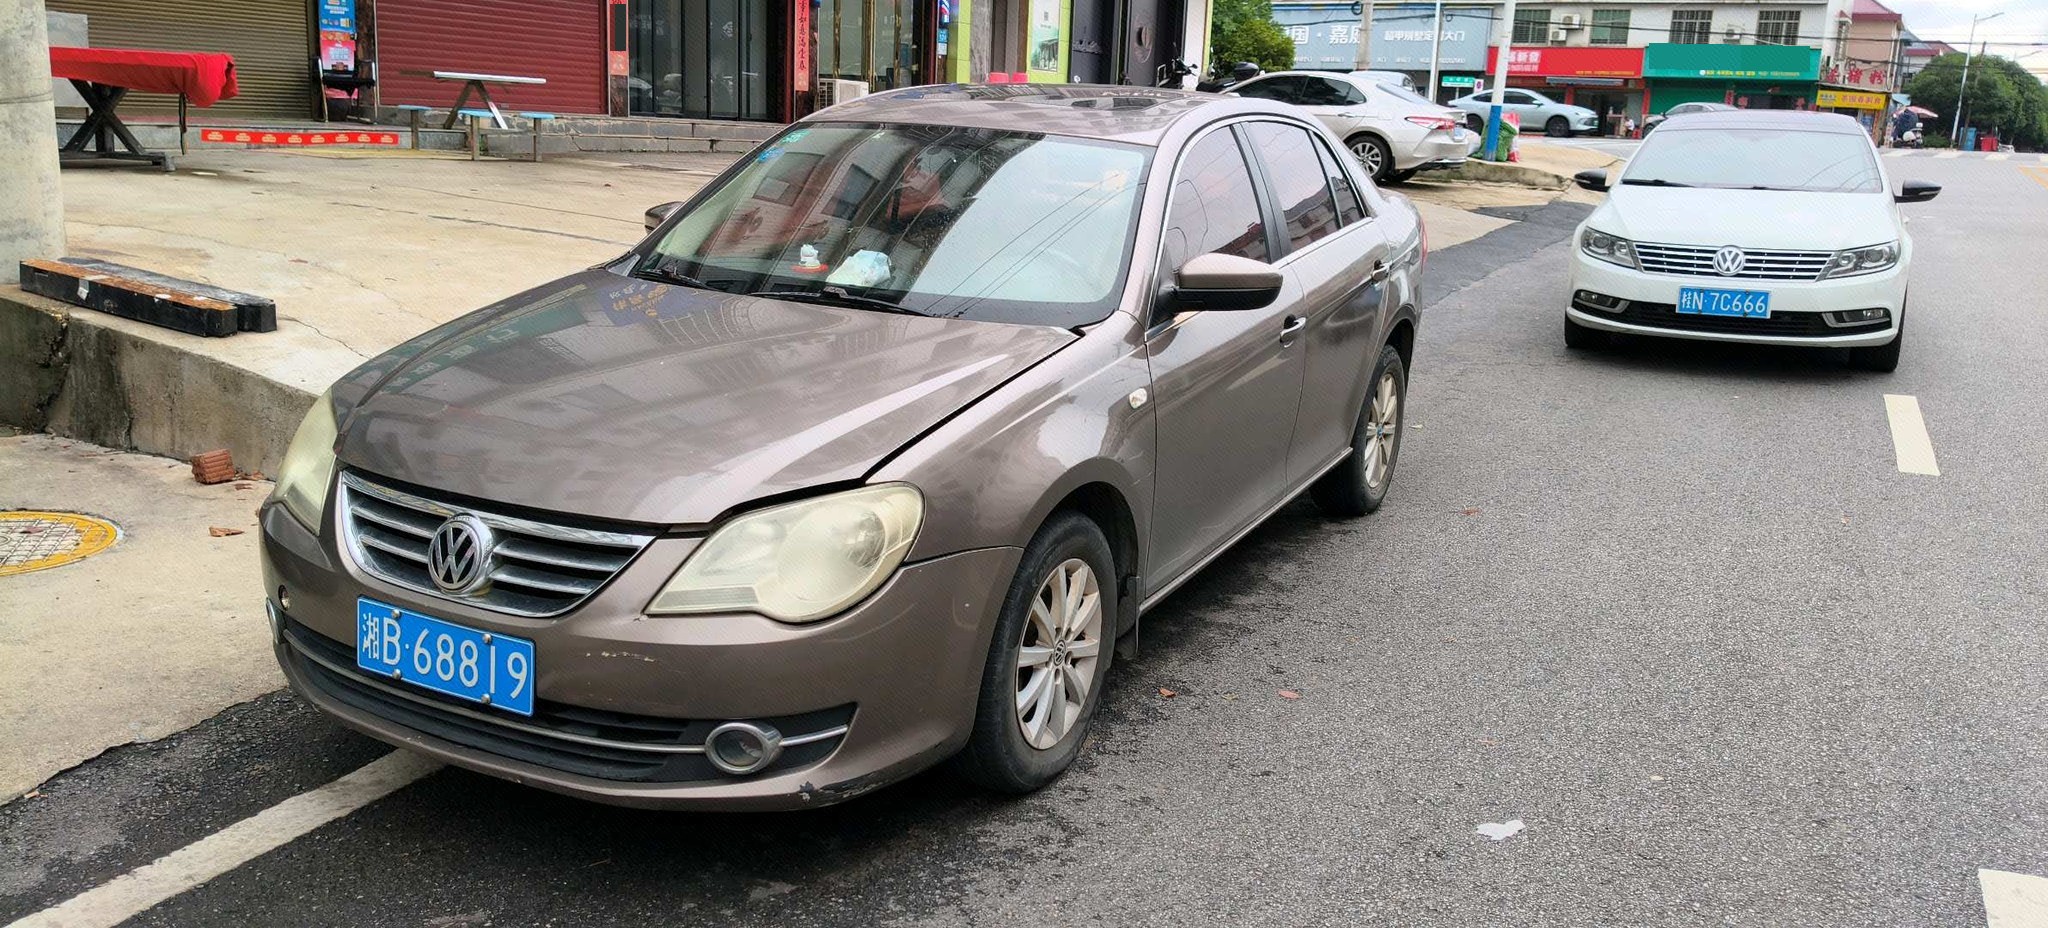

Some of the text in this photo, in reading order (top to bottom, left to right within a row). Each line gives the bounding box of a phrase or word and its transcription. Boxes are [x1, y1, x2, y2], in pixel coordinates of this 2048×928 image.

[1286, 25, 1361, 45] 国·嘉
[1682, 291, 1766, 313] 桂N·7C666
[362, 612, 529, 700] 湘B·68819
